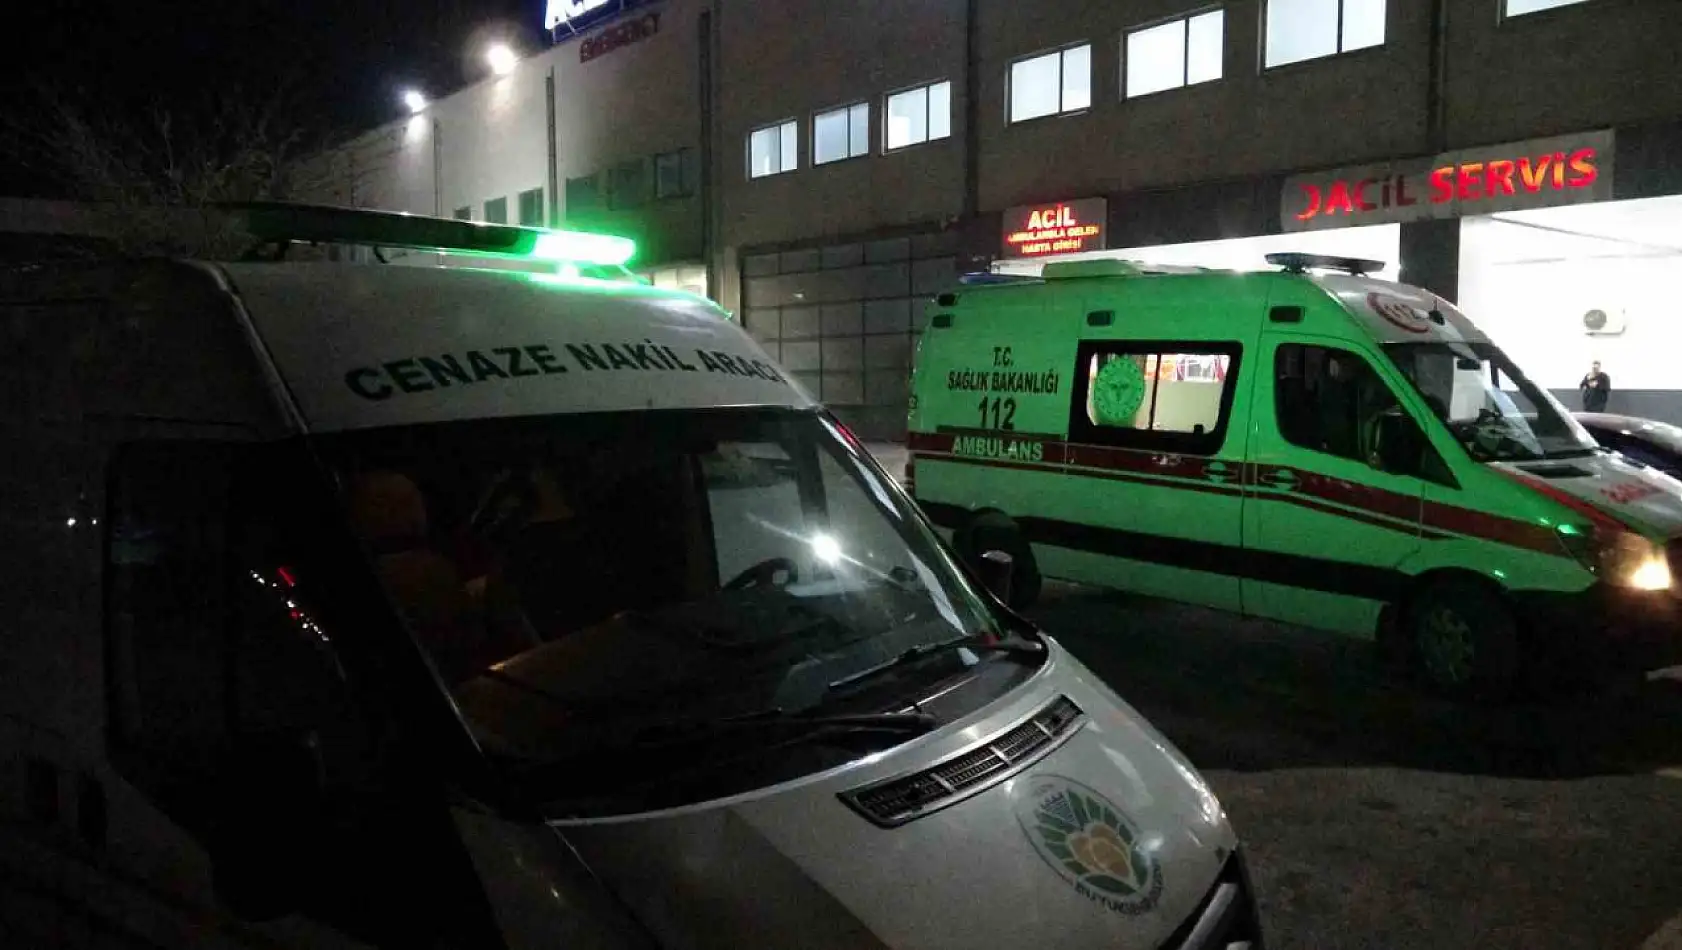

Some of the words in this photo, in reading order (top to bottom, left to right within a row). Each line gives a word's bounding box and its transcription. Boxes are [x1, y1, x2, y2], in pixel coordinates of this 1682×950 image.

[1429, 147, 1597, 205] SERVİS
[345, 344, 568, 401] CENAZE
[565, 339, 697, 372] NAKİL
[992, 346, 1013, 366] T.C.
[948, 367, 990, 391] SAĞLIK
[991, 368, 1059, 395] BAKANLIĞI
[978, 396, 1016, 431] 112
[952, 435, 1043, 461] AMBULANS
